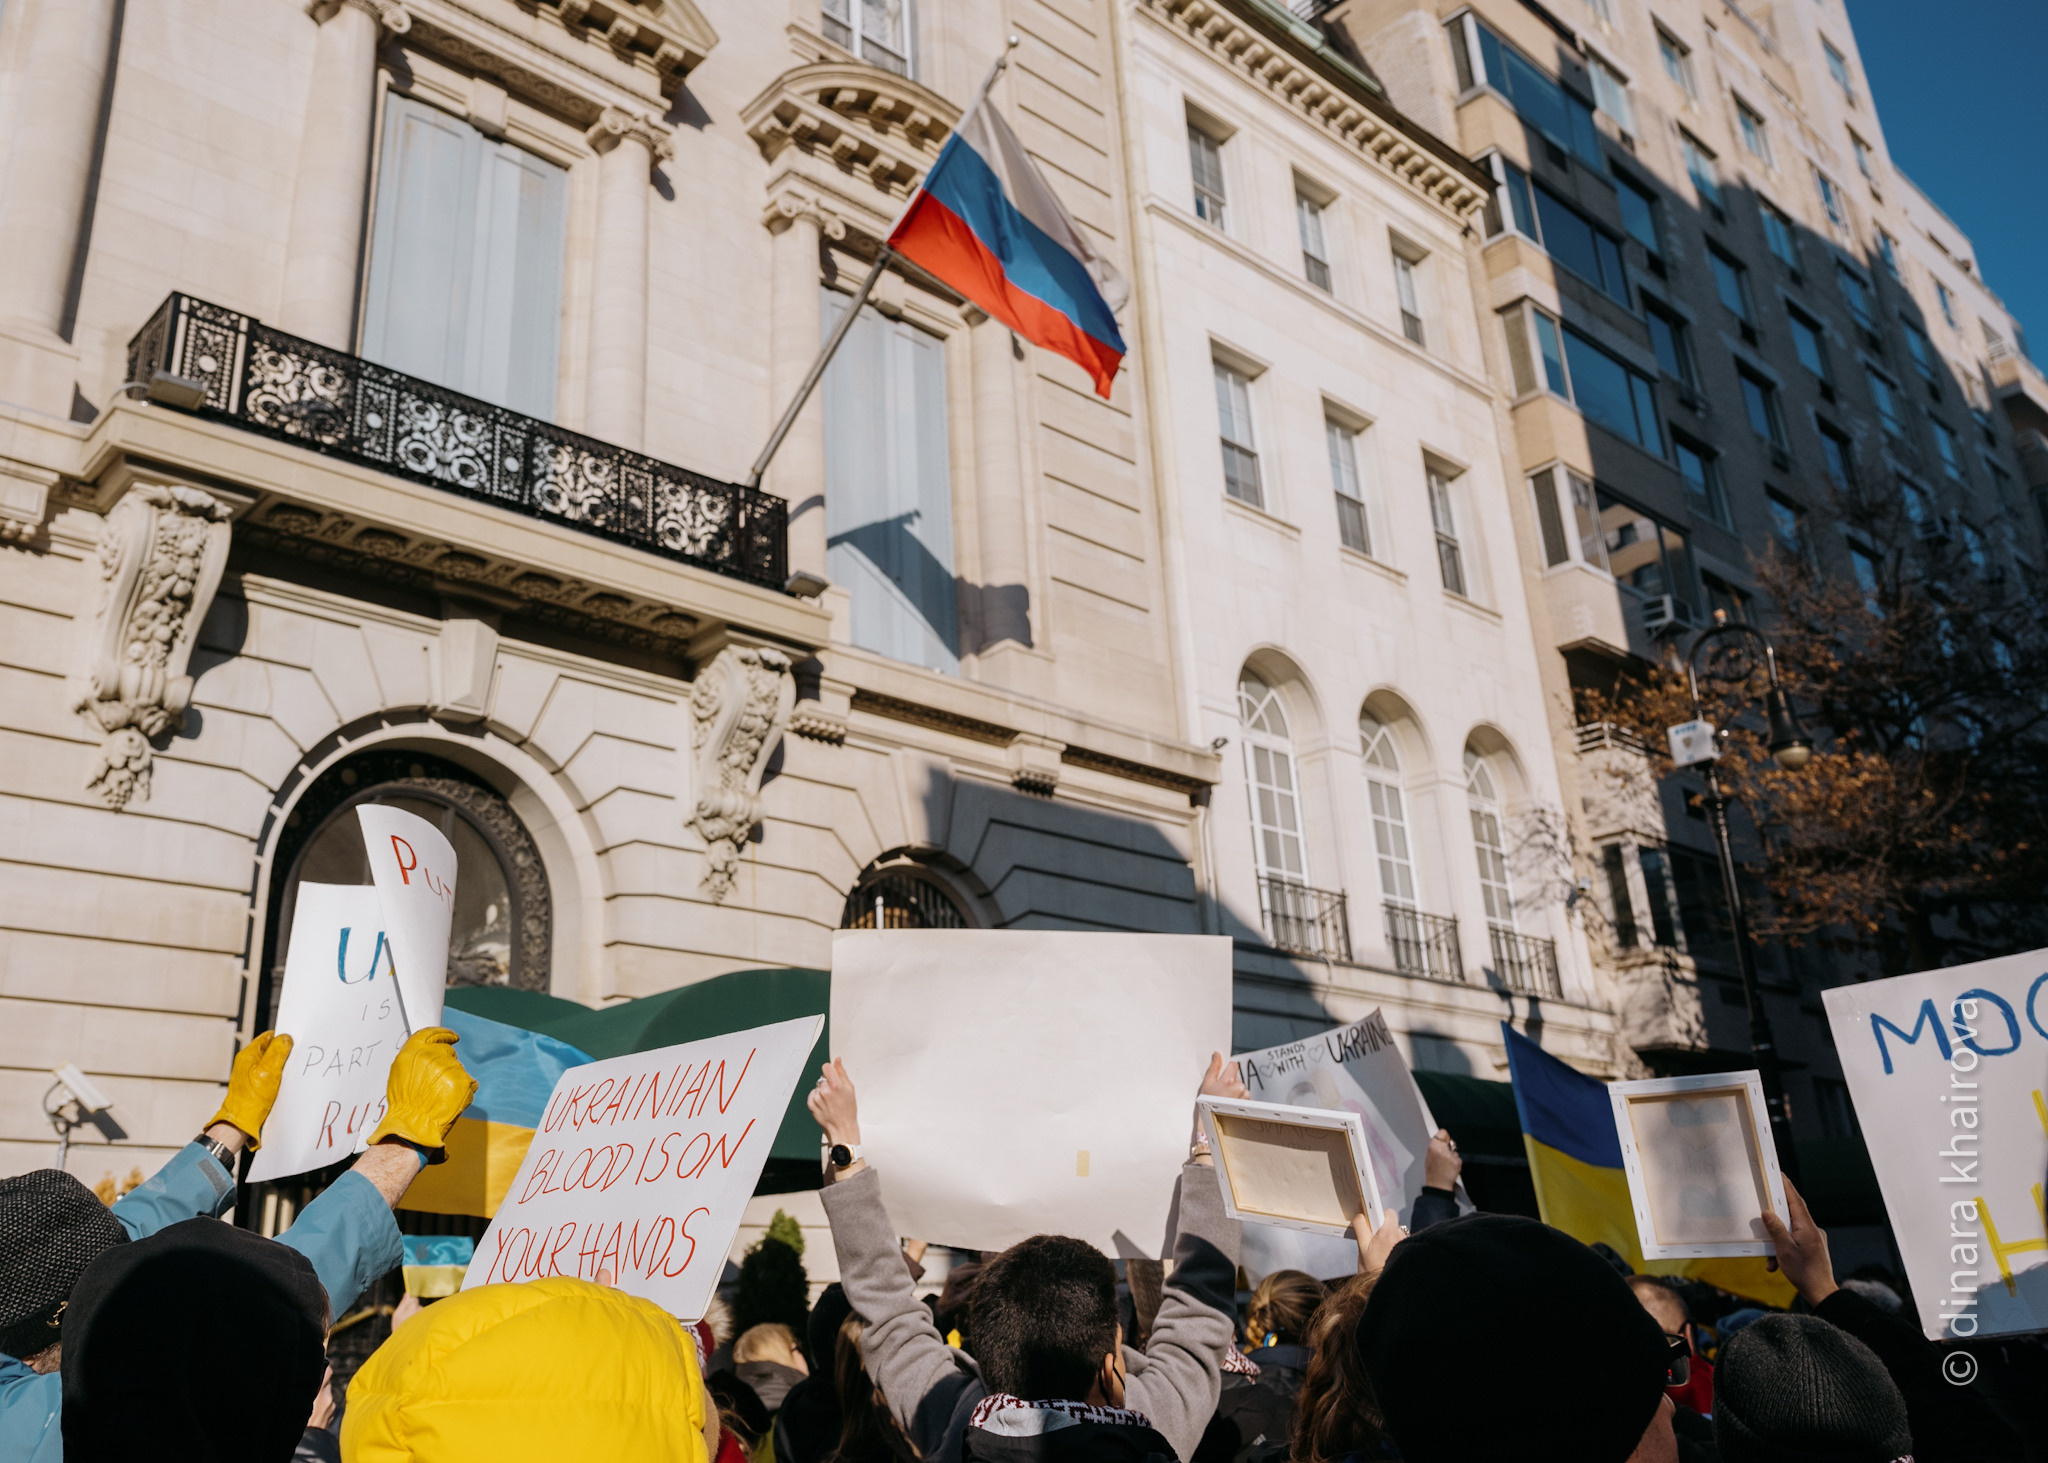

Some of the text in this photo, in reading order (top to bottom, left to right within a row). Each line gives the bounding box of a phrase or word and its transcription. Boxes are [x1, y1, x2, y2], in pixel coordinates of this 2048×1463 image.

[337, 926, 395, 985] U
[361, 998, 391, 1022] IS
[302, 1039, 383, 1077] PART
[1267, 1042, 1306, 1061] STANDS
[1276, 1054, 1308, 1076] WITH
[544, 1047, 757, 1133] UKRAINIAN
[517, 1118, 756, 1204] BLOOD IS ON
[486, 1207, 710, 1285] YOUR HANDS
